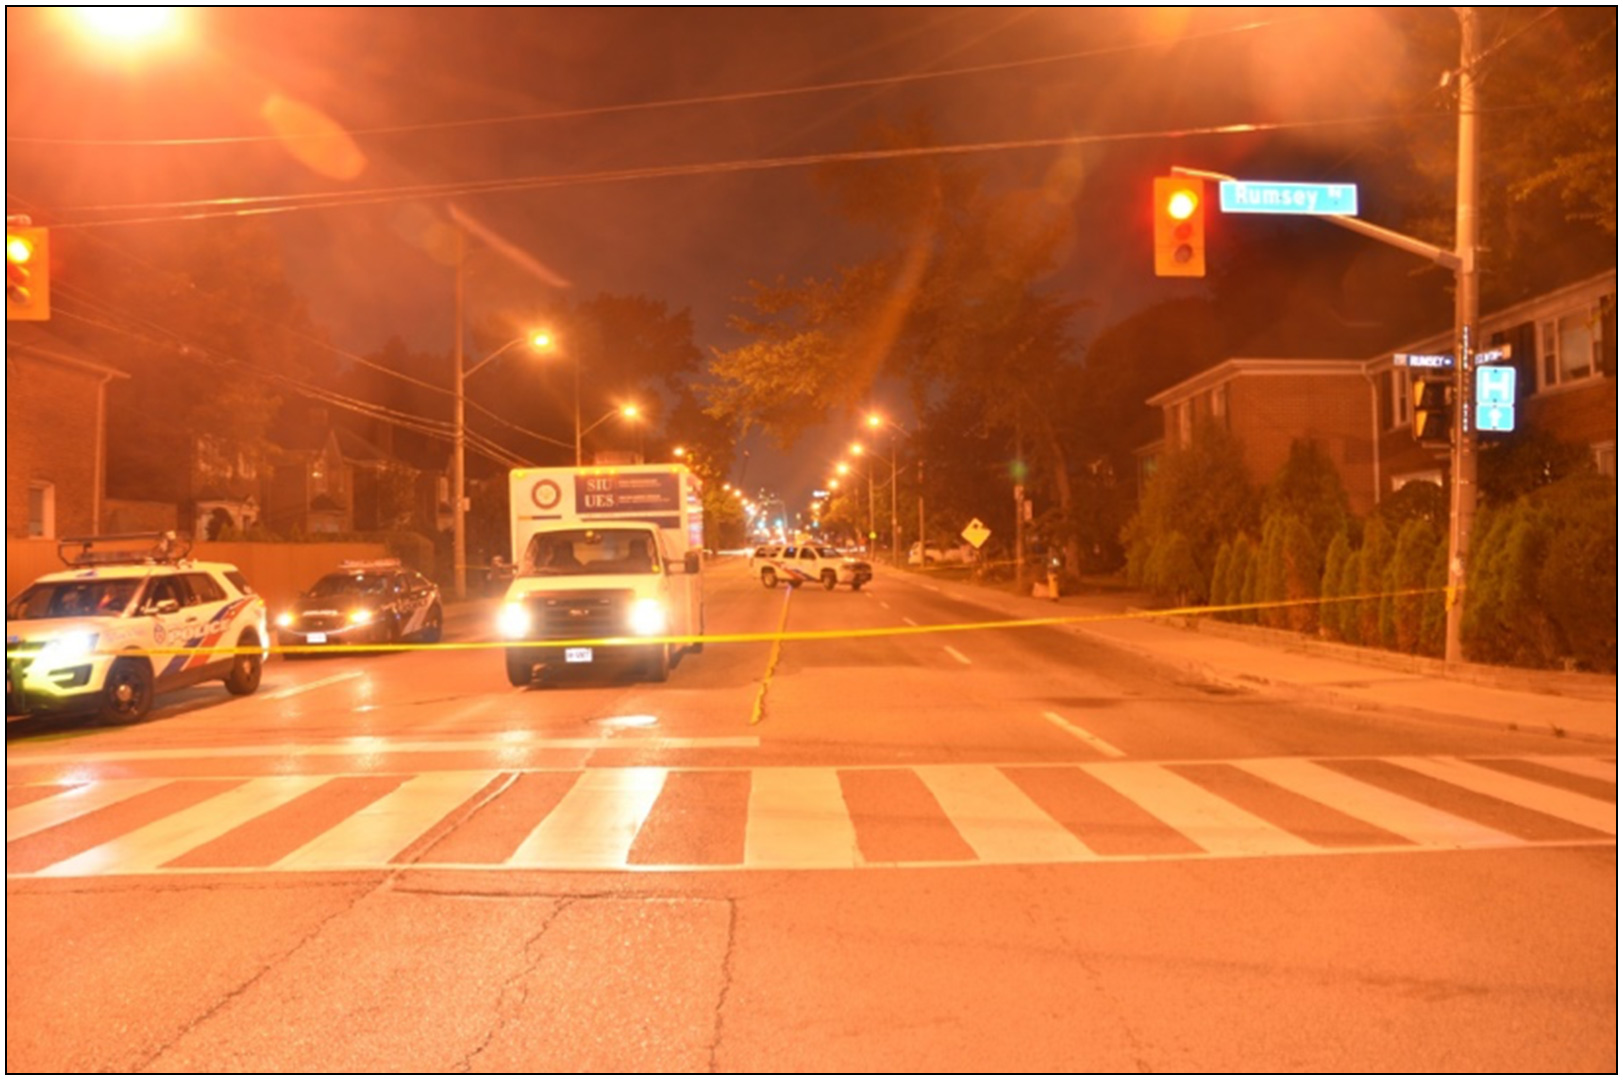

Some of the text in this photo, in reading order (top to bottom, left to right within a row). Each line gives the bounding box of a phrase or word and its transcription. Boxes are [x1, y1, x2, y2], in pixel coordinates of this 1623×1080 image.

[1235, 184, 1318, 212] Rumsey
[1481, 371, 1510, 401] H
[586, 479, 614, 492] SIU
[584, 494, 614, 508] UES
[167, 619, 230, 646] POLICE
